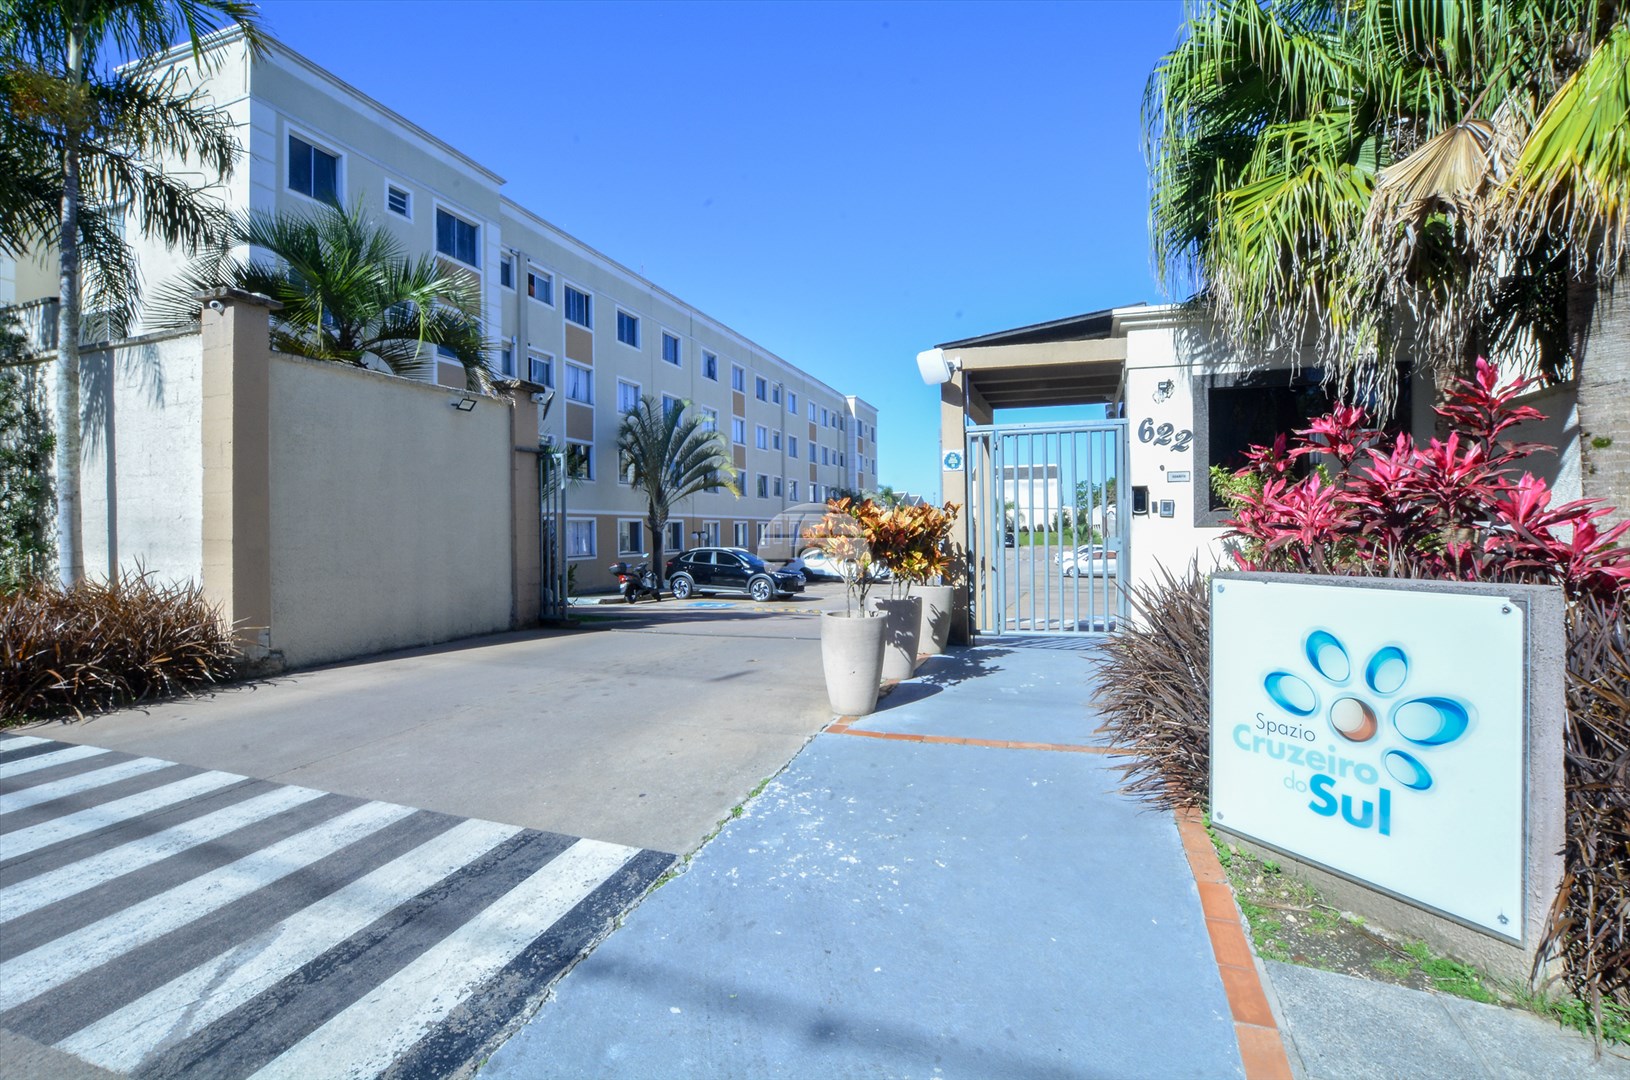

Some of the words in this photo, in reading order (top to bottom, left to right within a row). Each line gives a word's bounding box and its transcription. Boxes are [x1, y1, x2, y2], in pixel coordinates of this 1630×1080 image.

[1137, 417, 1193, 452] 622
[1255, 712, 1316, 742] Spazio
[1232, 723, 1379, 785] Cruzeiro
[1283, 769, 1307, 793] do
[1308, 773, 1391, 837] Sul
